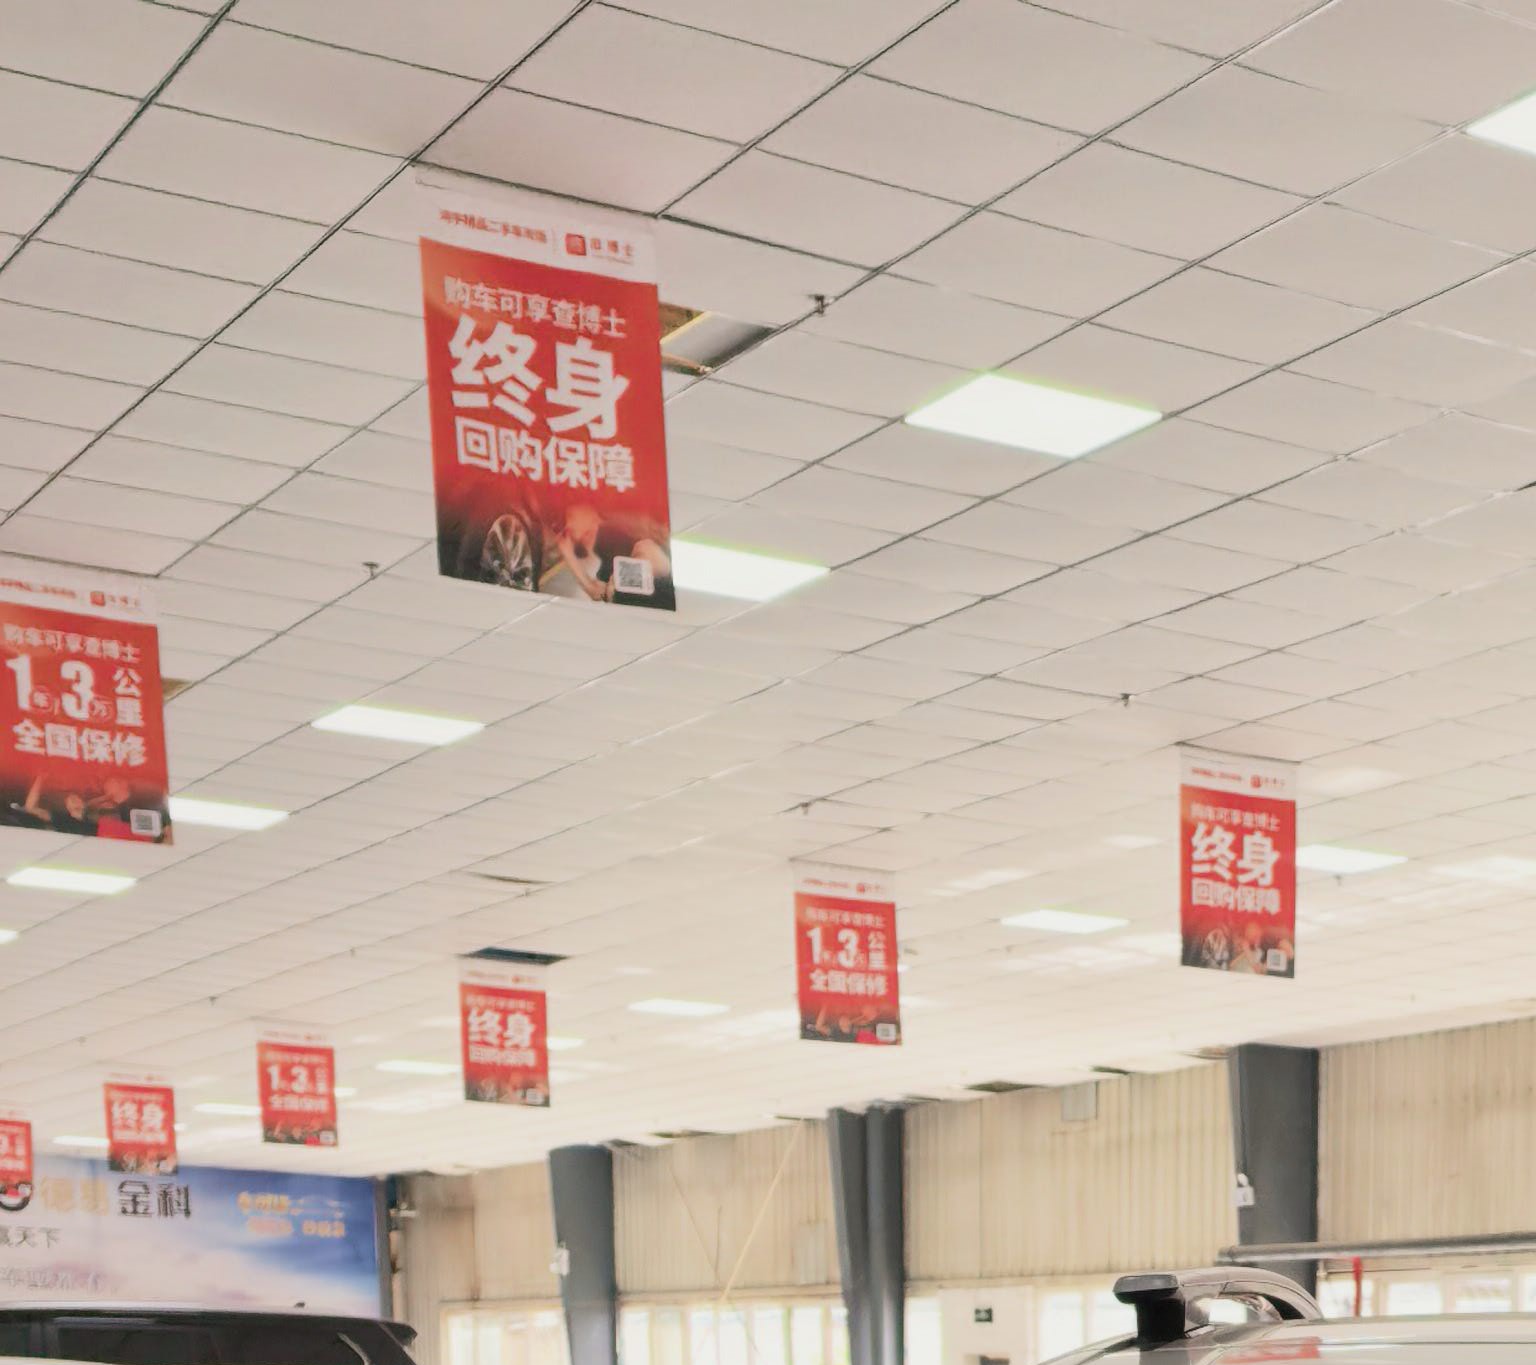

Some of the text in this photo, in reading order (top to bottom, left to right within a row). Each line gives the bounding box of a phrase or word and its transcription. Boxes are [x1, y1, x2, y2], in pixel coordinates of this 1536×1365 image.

[444, 275, 628, 338] 购车可享查博士
[448, 314, 630, 440] 终身
[454, 416, 637, 492] 回购保障
[12, 719, 147, 767] 全国保修
[1190, 822, 1280, 887] 终身
